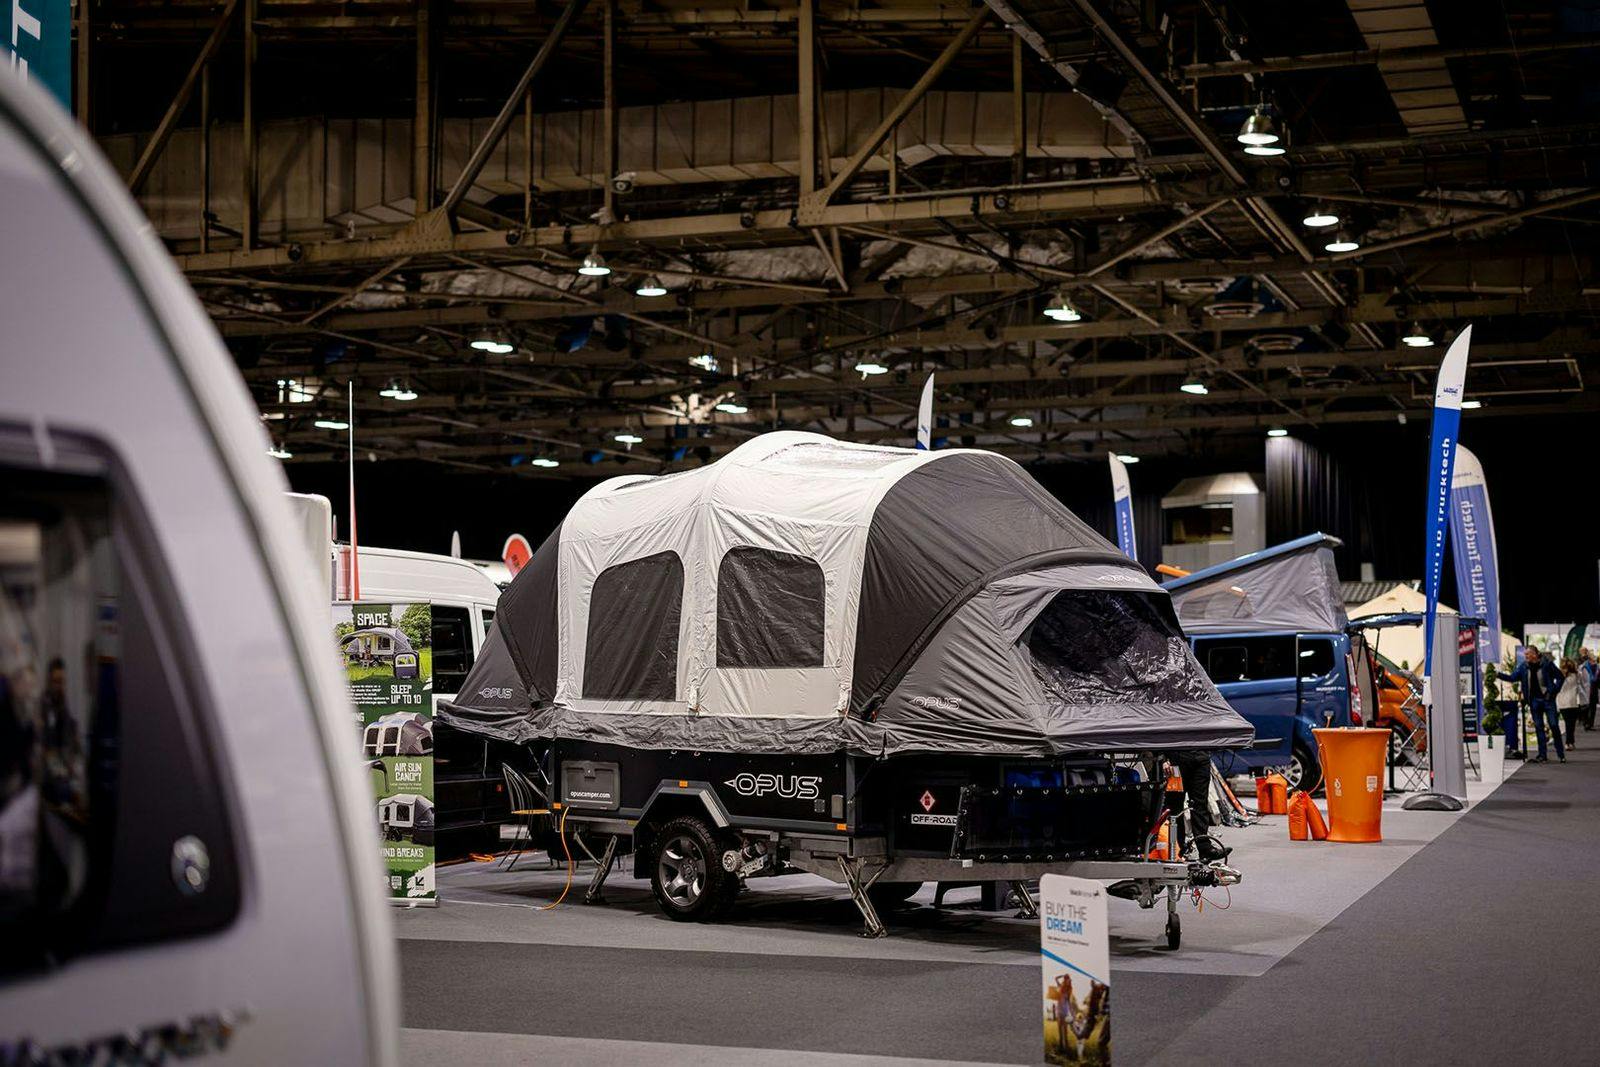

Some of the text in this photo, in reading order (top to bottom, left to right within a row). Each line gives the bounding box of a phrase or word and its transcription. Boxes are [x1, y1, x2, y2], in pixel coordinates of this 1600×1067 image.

[1437, 437, 1450, 523] Trucktech
[357, 613, 388, 626] SPACE
[390, 685, 412, 694] SLEEP
[480, 687, 513, 699] OPUS
[391, 695, 401, 704] UP
[402, 695, 412, 704] TO
[413, 694, 422, 704] 10
[912, 696, 962, 710] OPUS
[395, 762, 422, 772] AIR SUN
[395, 771, 422, 781] CANOPY
[735, 773, 819, 799] OPUS
[396, 847, 424, 858] BREAKS
[1045, 901, 1088, 921] BUY THE
[1046, 916, 1083, 936] DREAM
